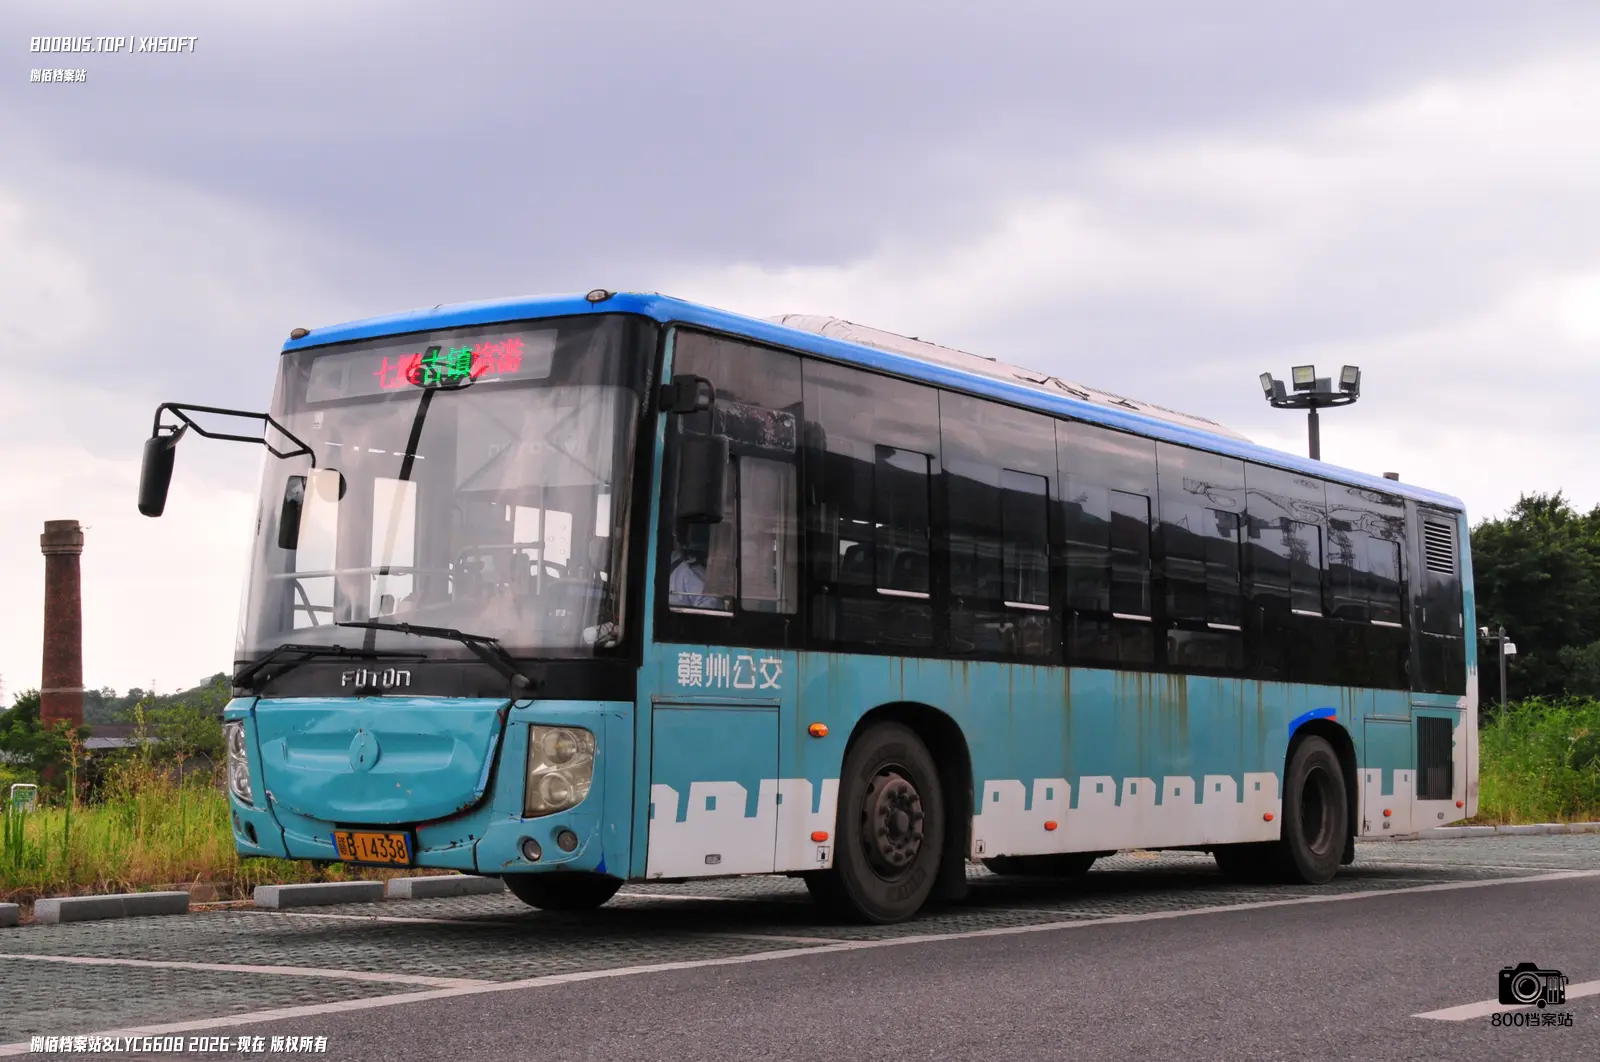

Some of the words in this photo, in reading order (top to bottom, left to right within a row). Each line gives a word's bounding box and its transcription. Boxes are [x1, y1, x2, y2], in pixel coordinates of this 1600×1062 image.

[341, 668, 411, 688] FOTON
[677, 651, 783, 689] 赣州公交
